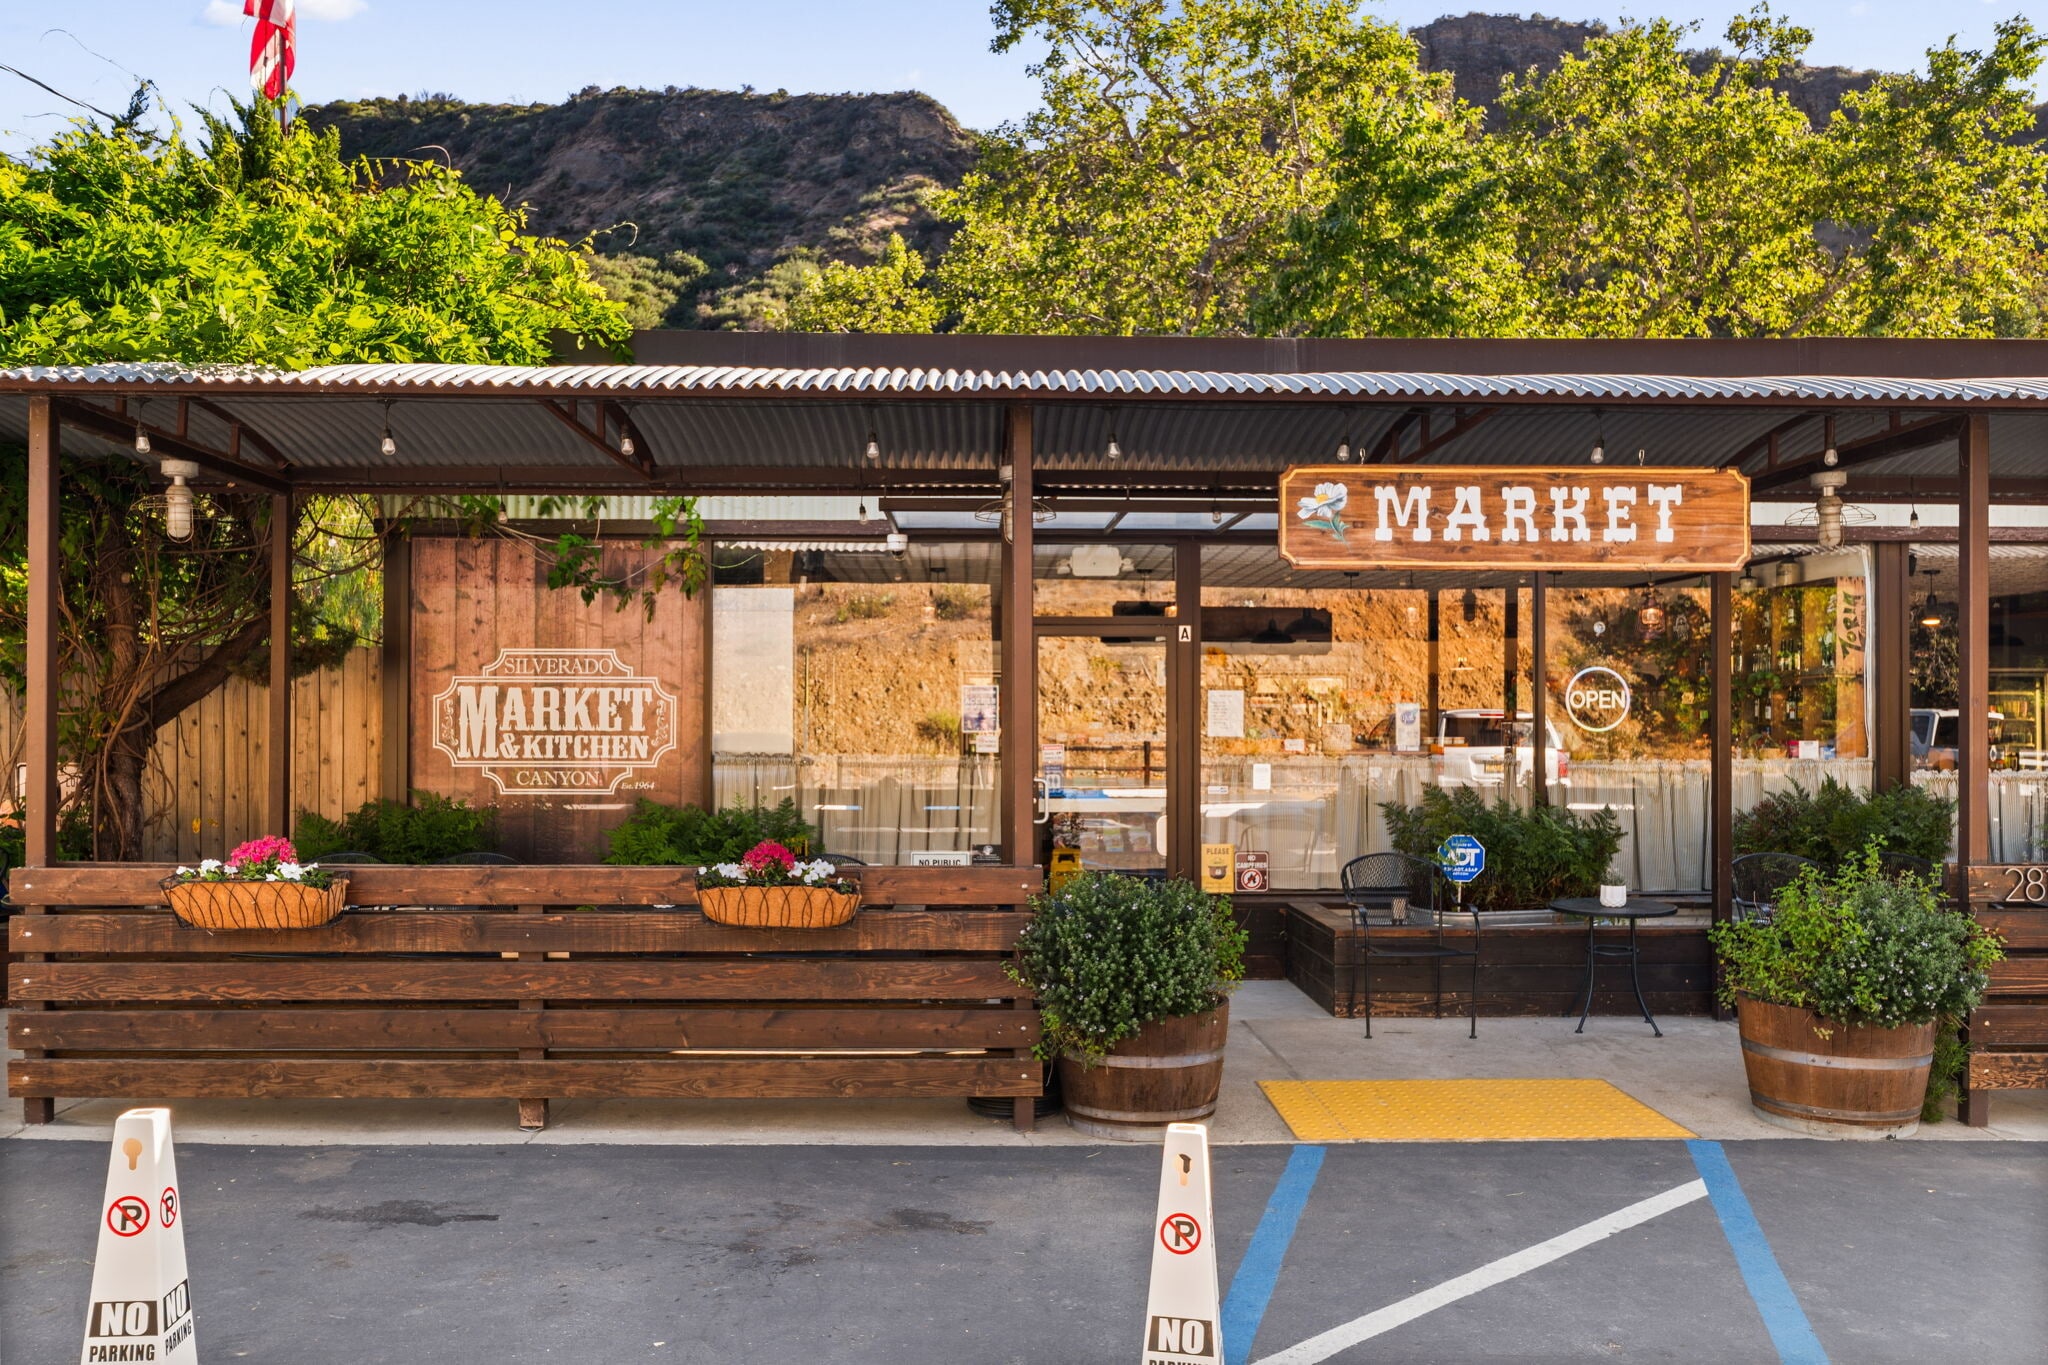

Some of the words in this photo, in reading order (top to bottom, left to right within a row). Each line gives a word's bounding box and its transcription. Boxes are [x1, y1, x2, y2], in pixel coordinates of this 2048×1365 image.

[1373, 483, 1683, 542] MARKET
[1180, 627, 1190, 640] A
[504, 657, 614, 674] SILVERADO
[1570, 689, 1626, 709] OPEN
[457, 685, 653, 758] MARKET
[522, 734, 649, 759] KITCHEN
[516, 770, 601, 786] CANYON
[634, 781, 655, 790] 1964
[1206, 847, 1229, 855] PLEASE
[1236, 861, 1267, 869] CAMPFIRES
[2005, 867, 2048, 902] 28
[165, 1283, 188, 1328] NO
[99, 1301, 150, 1337] NO
[164, 1319, 192, 1357] PARKING
[1158, 1317, 1205, 1355] NO
[89, 1343, 156, 1363] PARKING
